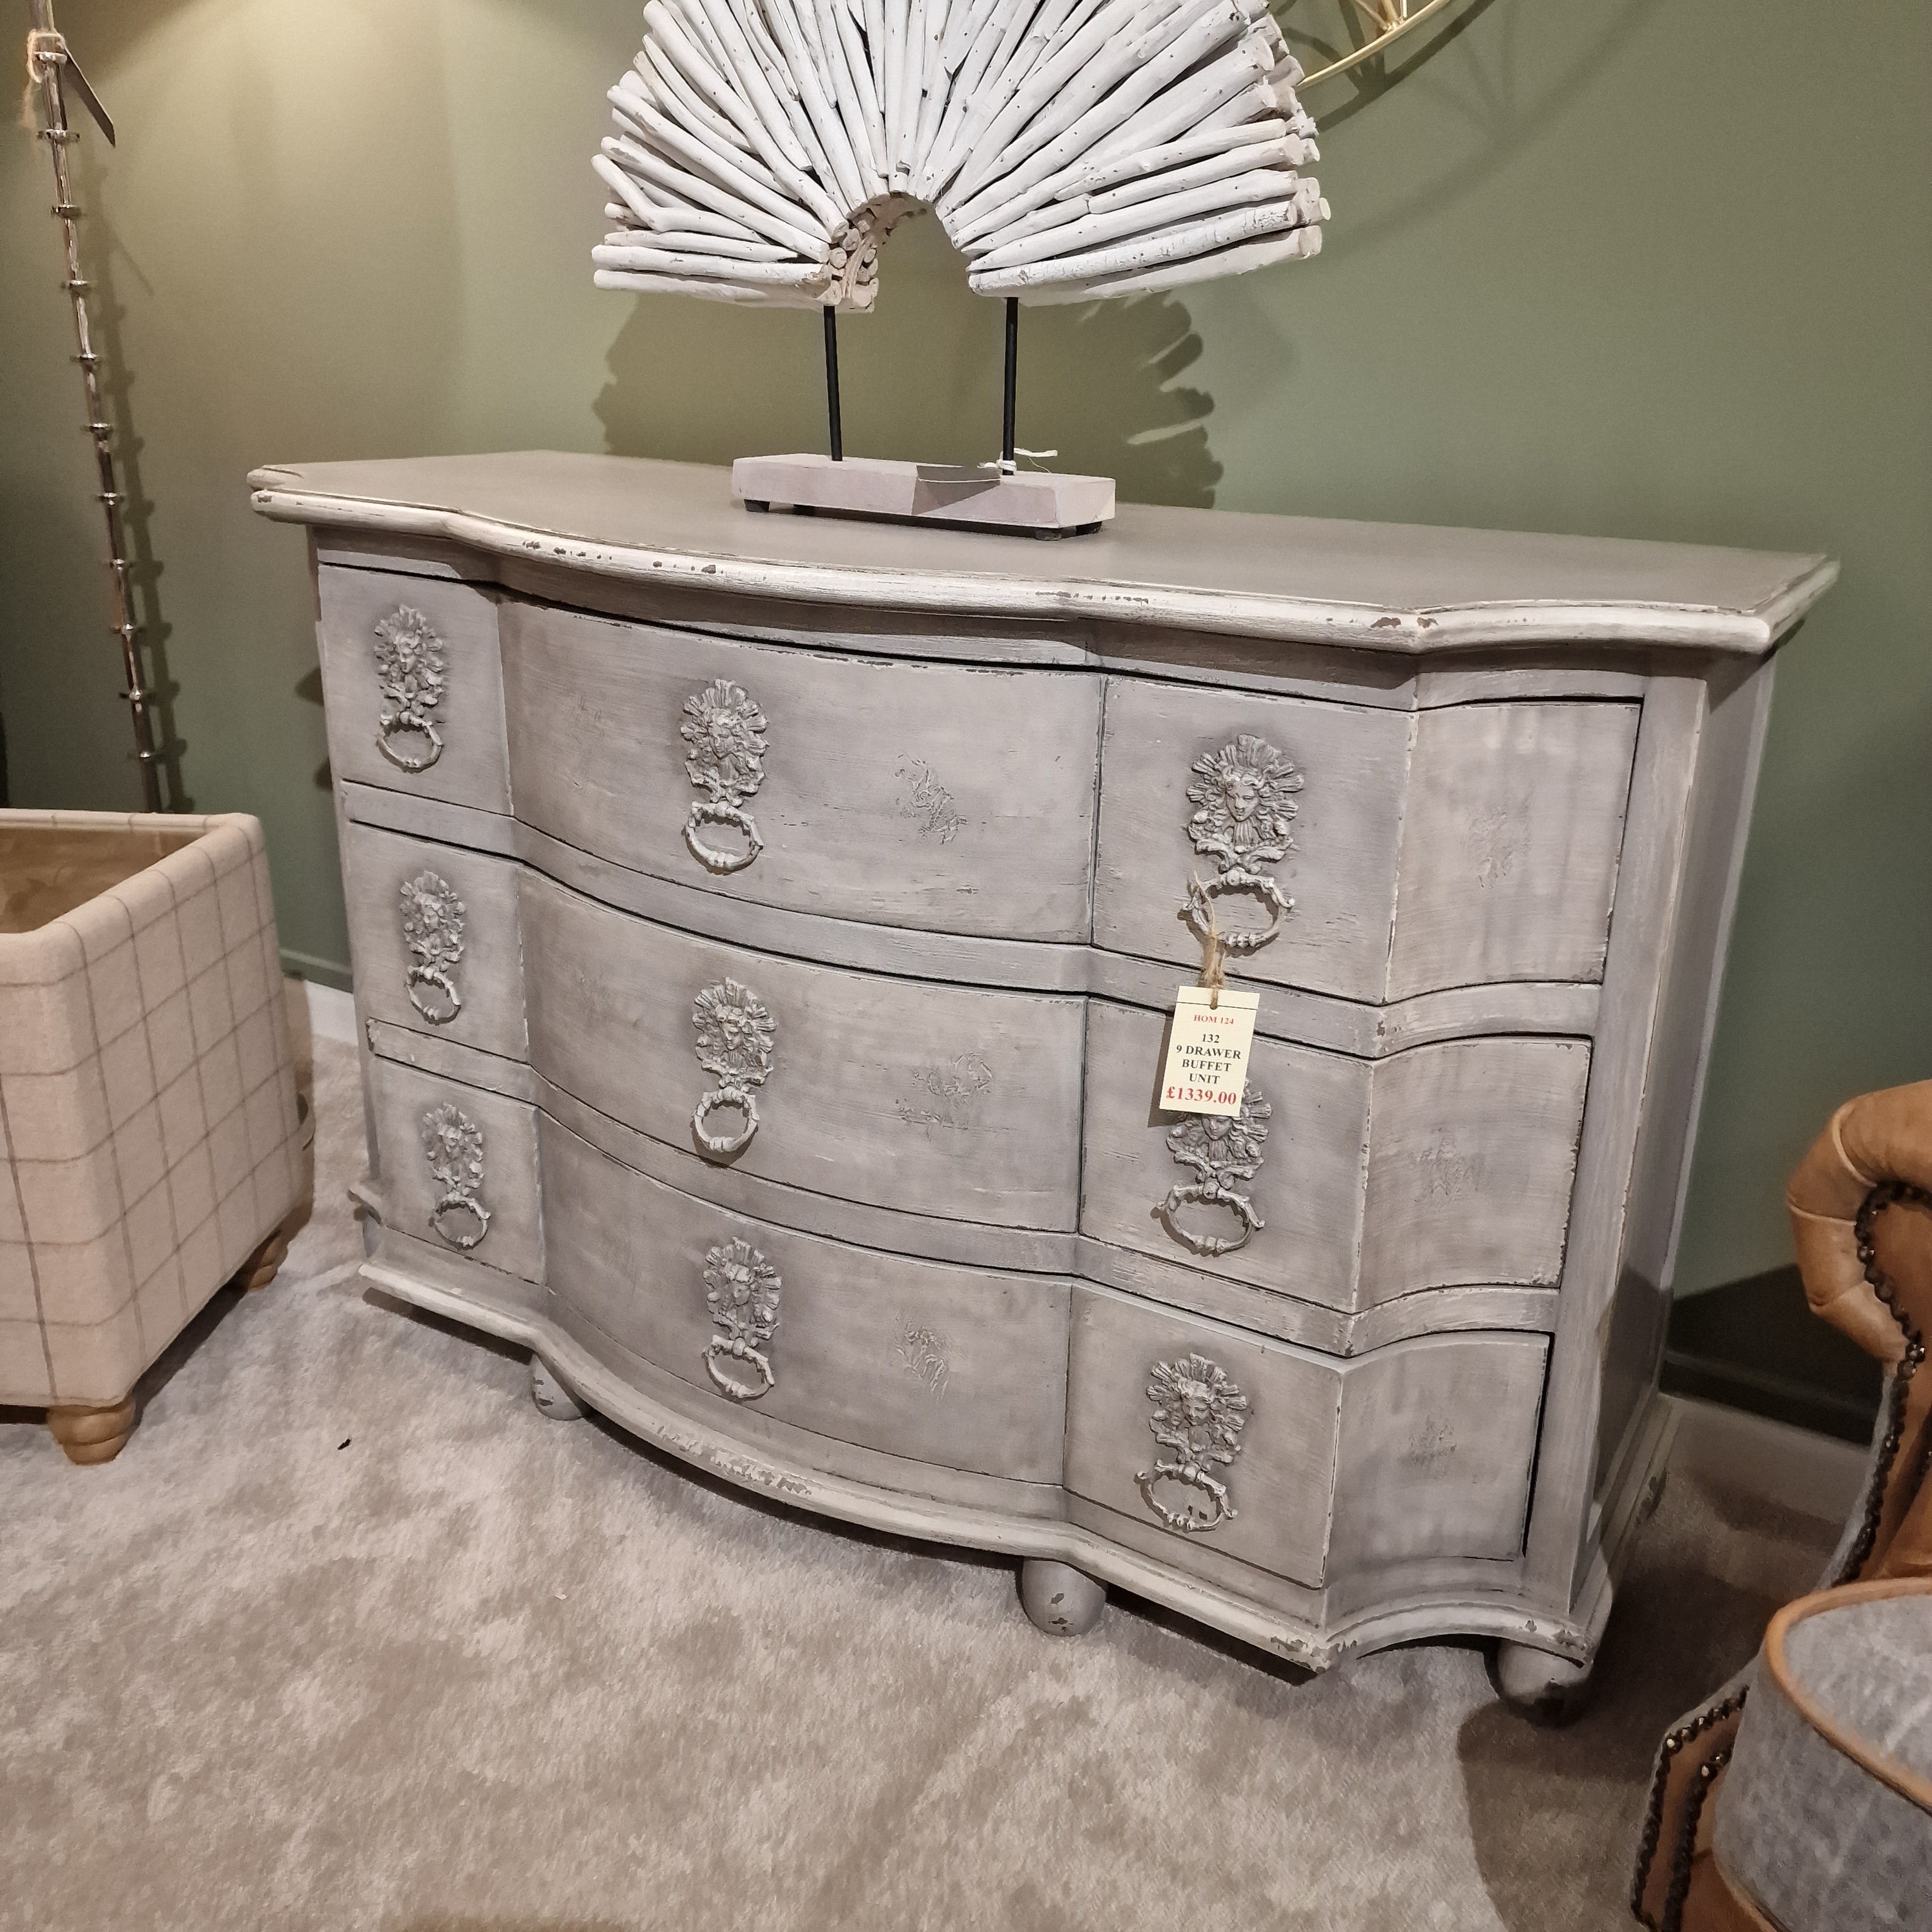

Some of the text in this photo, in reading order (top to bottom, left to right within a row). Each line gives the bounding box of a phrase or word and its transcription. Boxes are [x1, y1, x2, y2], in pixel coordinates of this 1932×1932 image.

[1193, 1014, 1217, 1023] HOM
[1202, 1034, 1220, 1043] 132
[1176, 1045, 1241, 1059] 9 DRAWER
[1182, 1059, 1231, 1072] BUFFET
[1189, 1073, 1220, 1084] UNIT
[1166, 1086, 1237, 1105] £1339.00
